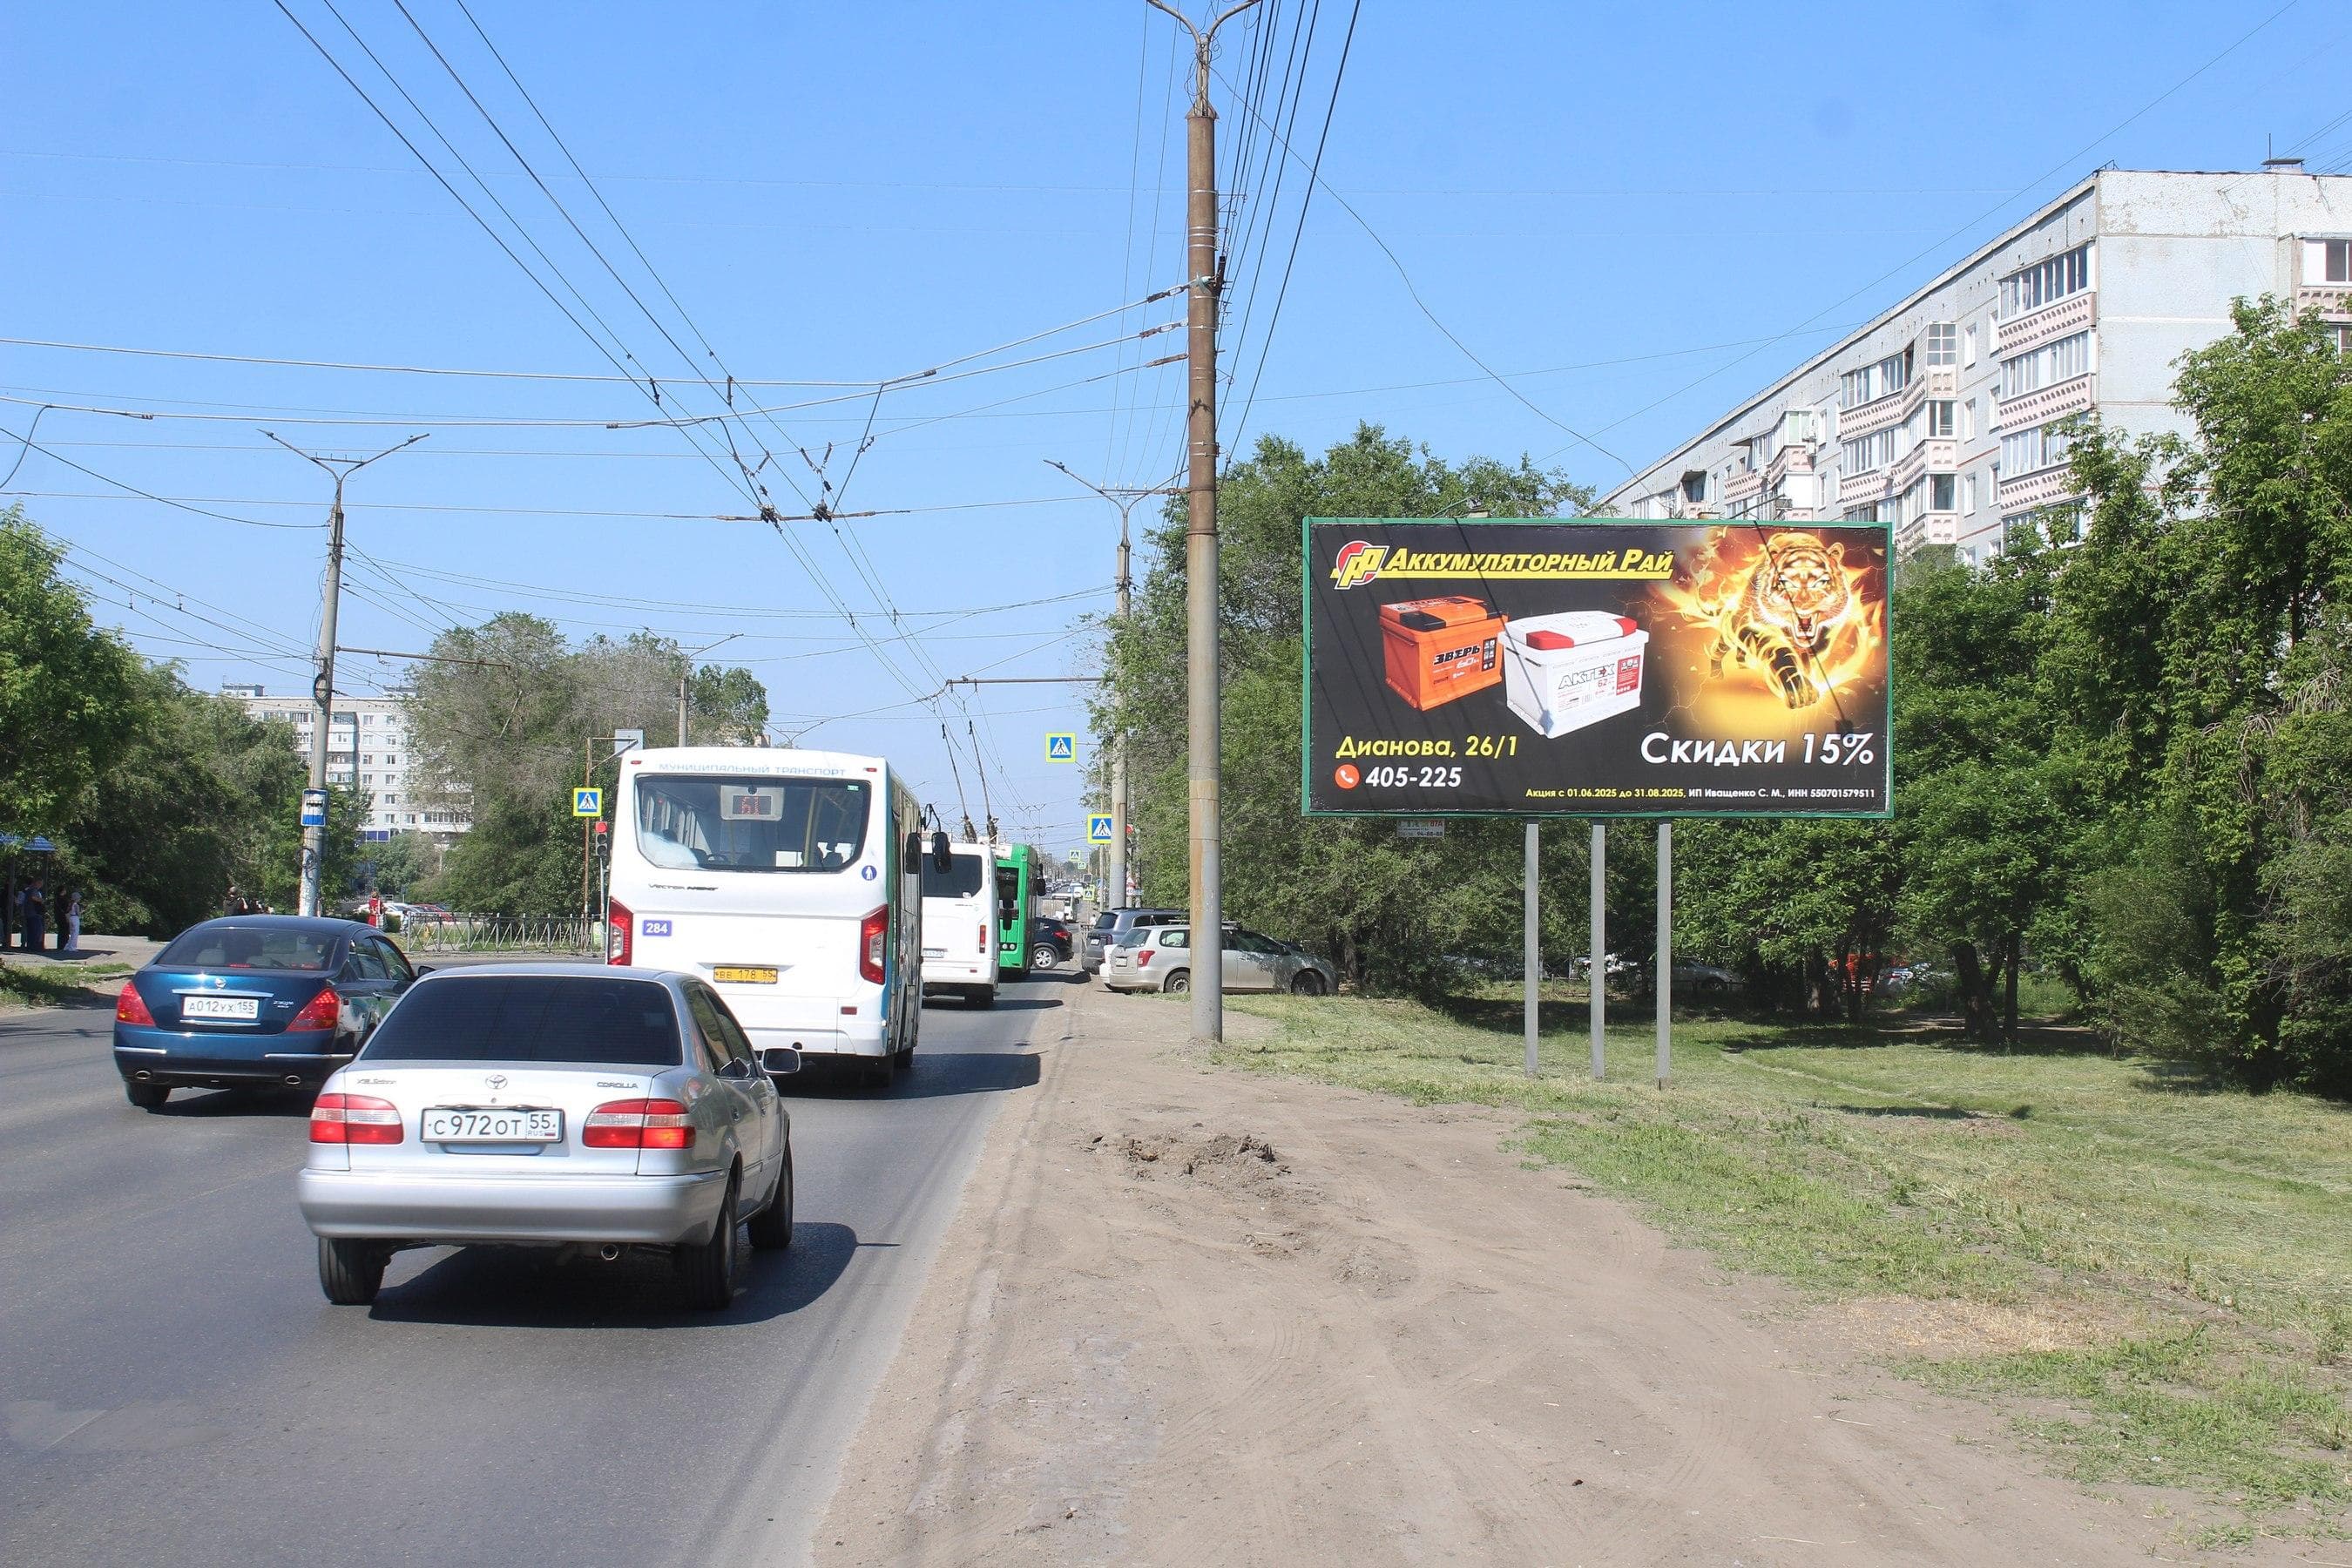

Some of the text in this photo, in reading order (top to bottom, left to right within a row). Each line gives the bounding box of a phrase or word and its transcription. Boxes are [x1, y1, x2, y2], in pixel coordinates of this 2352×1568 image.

[1335, 735, 1518, 759] Дианова, 26/1
[1802, 733, 1874, 766] 15%
[659, 763, 846, 776] МУНИЦИПАЛЬНЫЙ ТРАНСПОРТ
[1365, 767, 1463, 787] 405-225
[1525, 788, 1556, 799] Акция
[1567, 788, 1617, 798] 01.06.2025
[1634, 788, 1686, 800] 31.08.2025,
[1688, 788, 1702, 798] ИП
[1705, 788, 1756, 800] Иващенко
[1758, 789, 1768, 798] С.
[1771, 788, 1786, 800] М.,
[1788, 788, 1808, 798] ИНН
[1810, 788, 1876, 798] 550701579511
[645, 923, 668, 934] 284
[530, 1114, 551, 1130] 55
